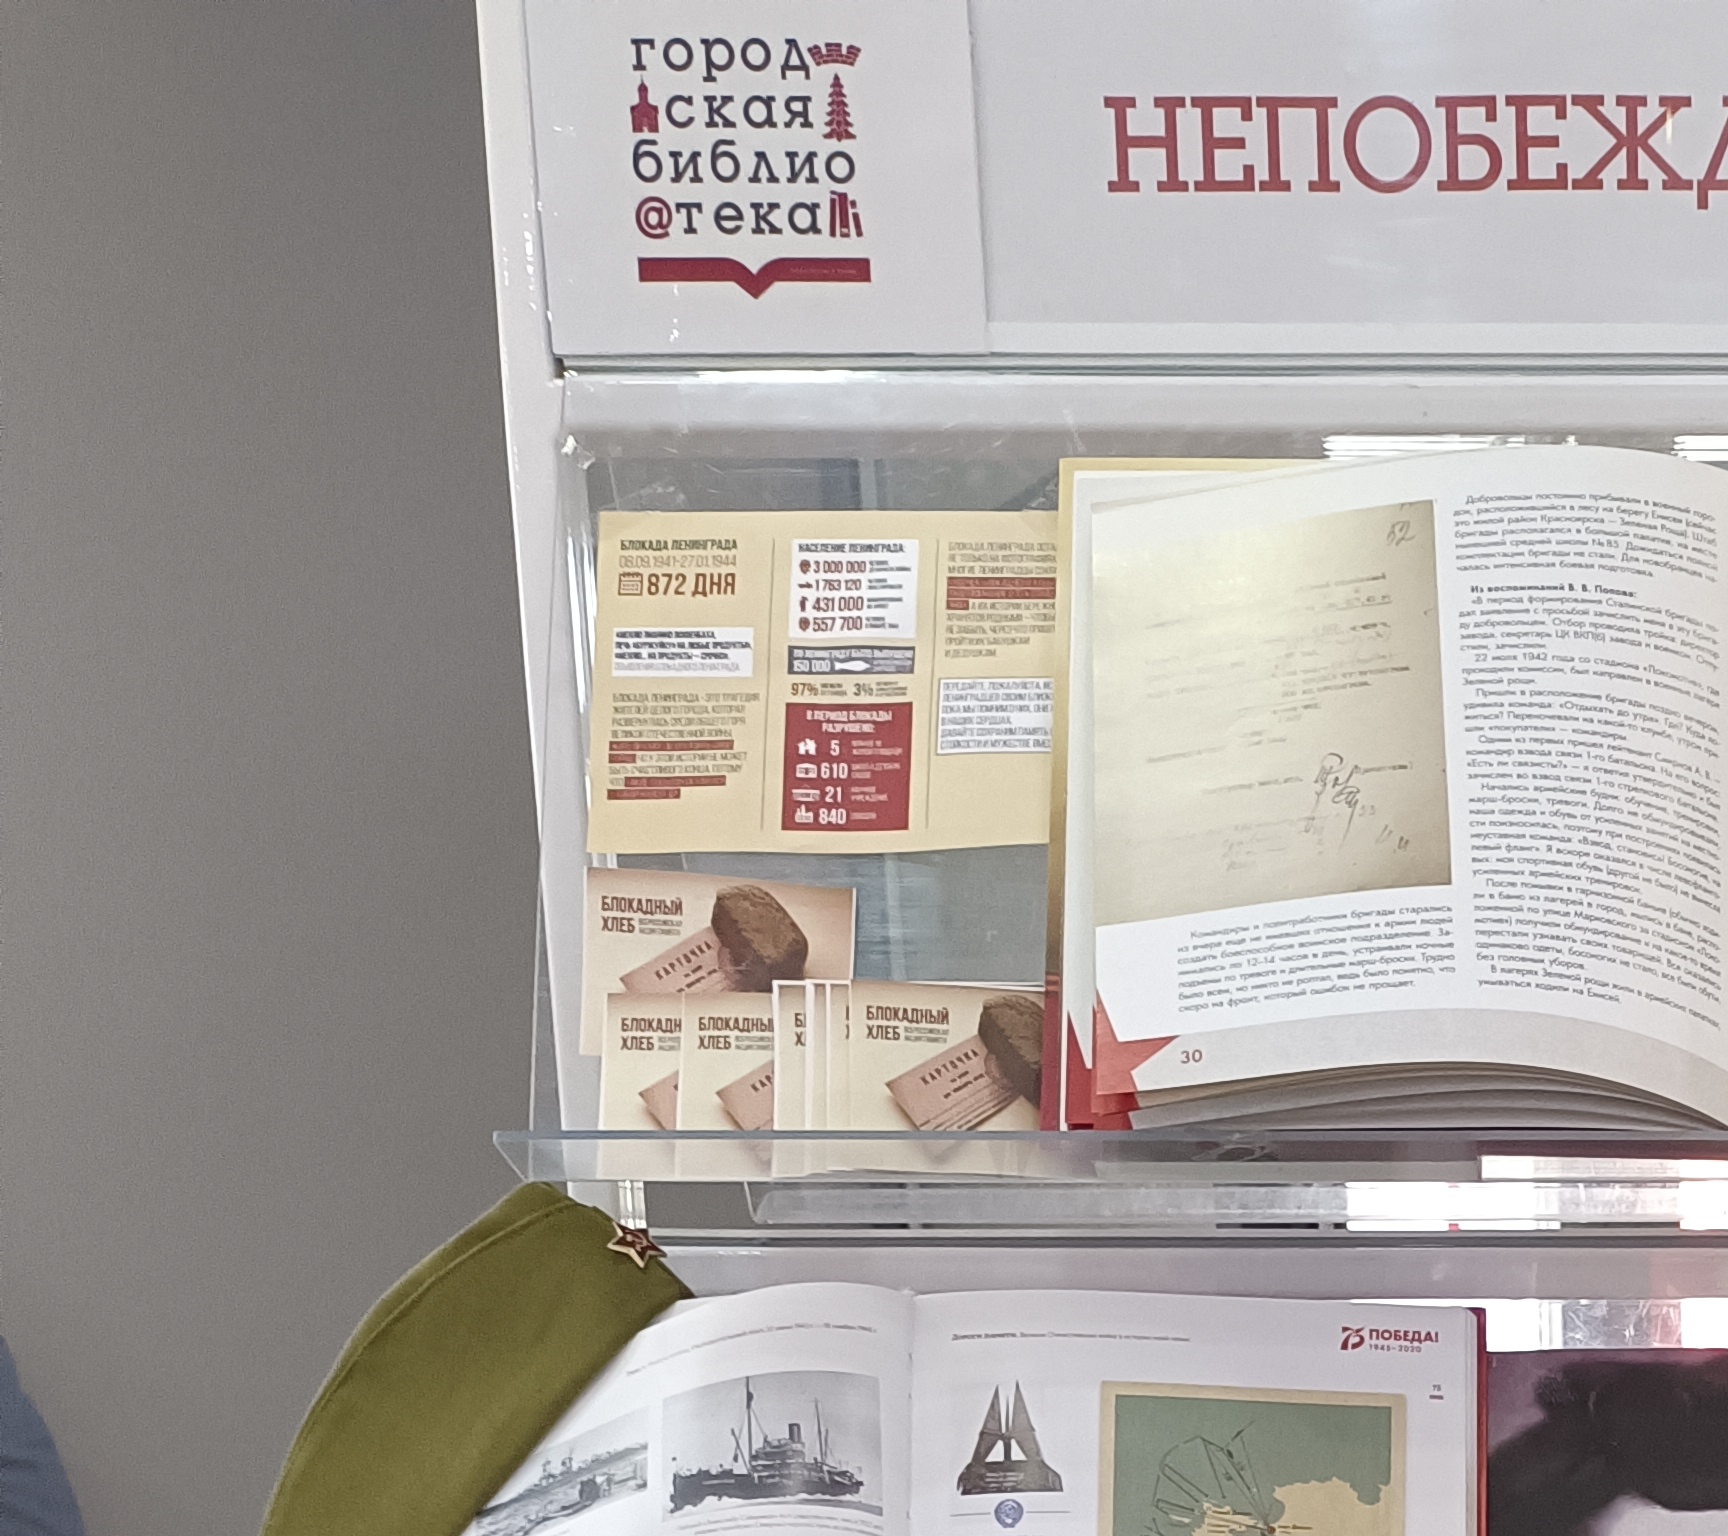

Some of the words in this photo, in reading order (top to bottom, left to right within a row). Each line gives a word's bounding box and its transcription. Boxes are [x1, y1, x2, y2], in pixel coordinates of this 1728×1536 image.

[631, 37, 811, 82] город
[665, 95, 813, 129] ская
[632, 139, 855, 184] библио
[635, 196, 822, 239] @тека
[620, 539, 669, 551] БЛОКАДА
[671, 539, 738, 551] ЛЕНИНГРАДА
[647, 573, 687, 595] 872
[692, 573, 736, 597] ДНЯ
[812, 597, 835, 612] 431
[838, 596, 864, 611] 000
[812, 617, 836, 632] 557
[838, 616, 863, 631] 700
[830, 740, 840, 756] 5
[820, 762, 848, 779] 610
[825, 786, 842, 803] 21
[818, 808, 847, 825] 840
[601, 896, 683, 916] БЛОКАДНЫЙ
[601, 916, 635, 934] ХЛЕБ
[866, 1005, 949, 1025] БЛОКАДНЫЙ
[866, 1023, 901, 1041] ХЛЕБ
[620, 1035, 655, 1051] ХЛЕБ
[697, 1034, 732, 1050] ХЛЕБ
[1180, 1049, 1203, 1064] 30
[1369, 1329, 1440, 1345] ПОБЕДА!
